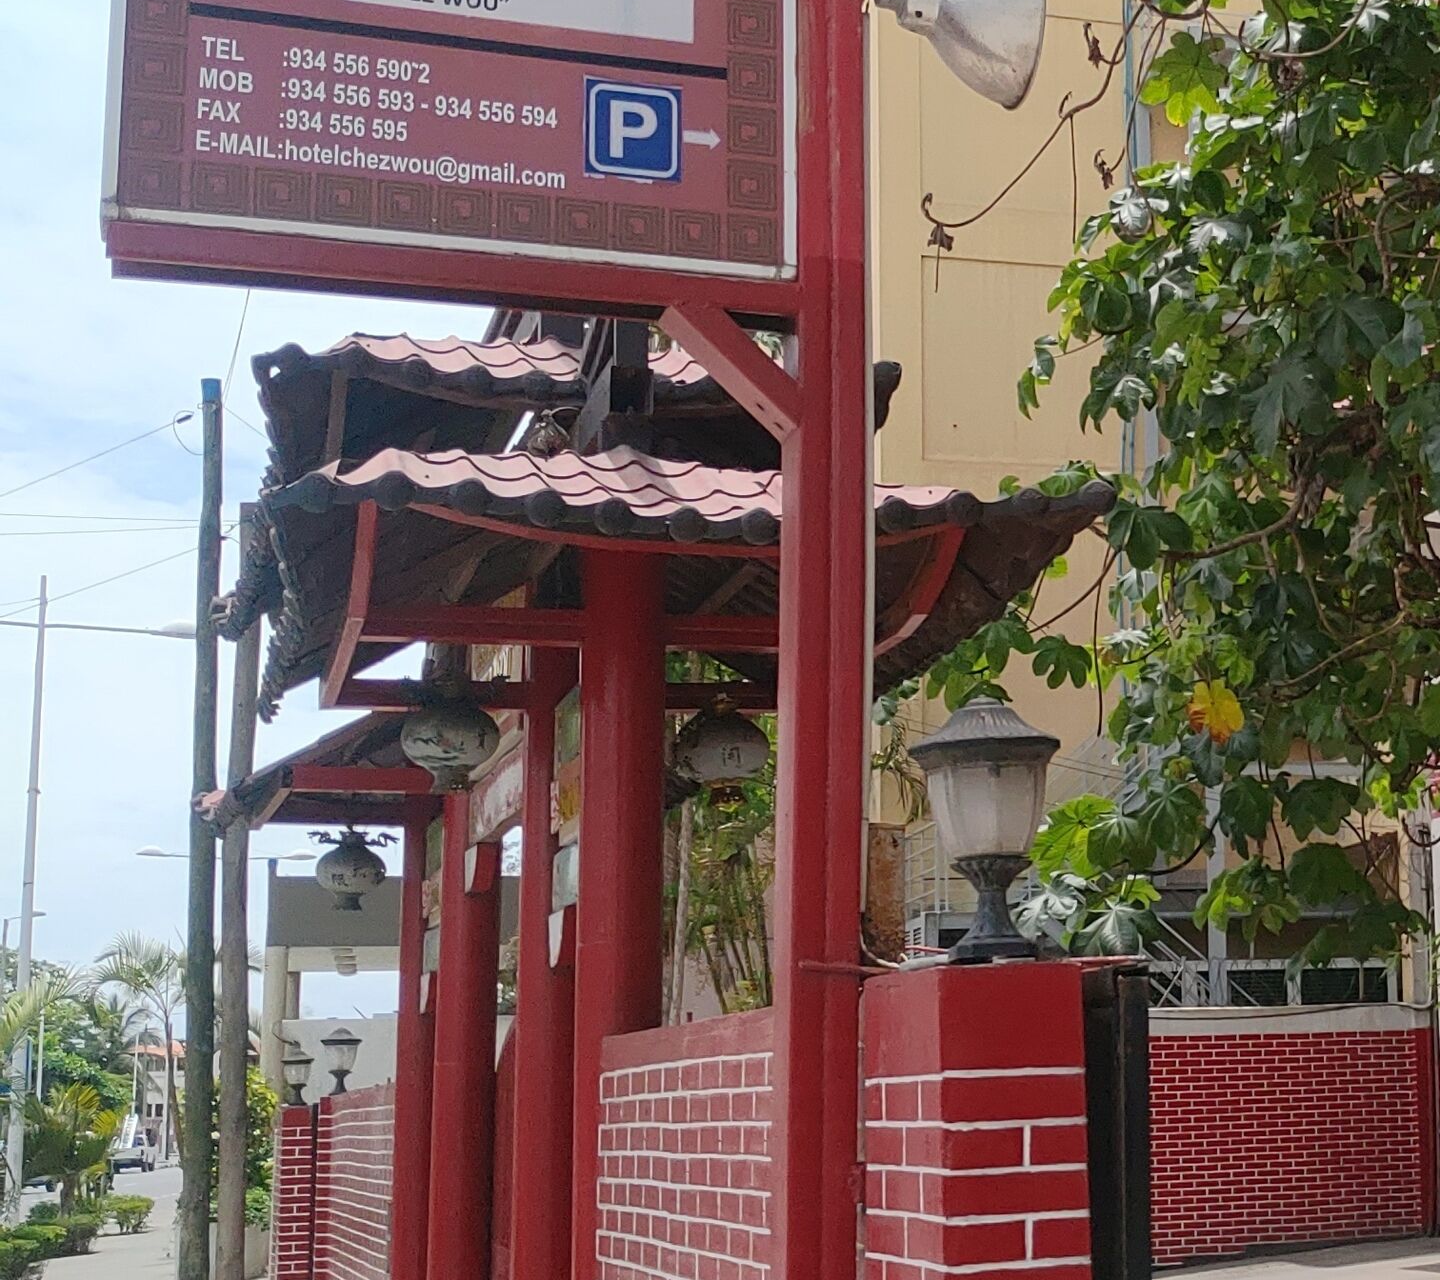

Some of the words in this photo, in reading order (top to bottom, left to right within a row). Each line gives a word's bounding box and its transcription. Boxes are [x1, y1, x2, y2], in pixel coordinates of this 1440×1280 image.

[201, 36, 245, 62] TEL
[333, 53, 369, 77] 556
[197, 99, 241, 124] FAX
[329, 114, 366, 138] 556
[371, 118, 408, 143] 595
[199, 67, 254, 94] MOB
[333, 84, 371, 108] 556
[377, 89, 416, 114] 593
[435, 95, 472, 120] 934
[478, 101, 515, 124] 556
[521, 105, 558, 130] 594
[608, 100, 658, 159] P
